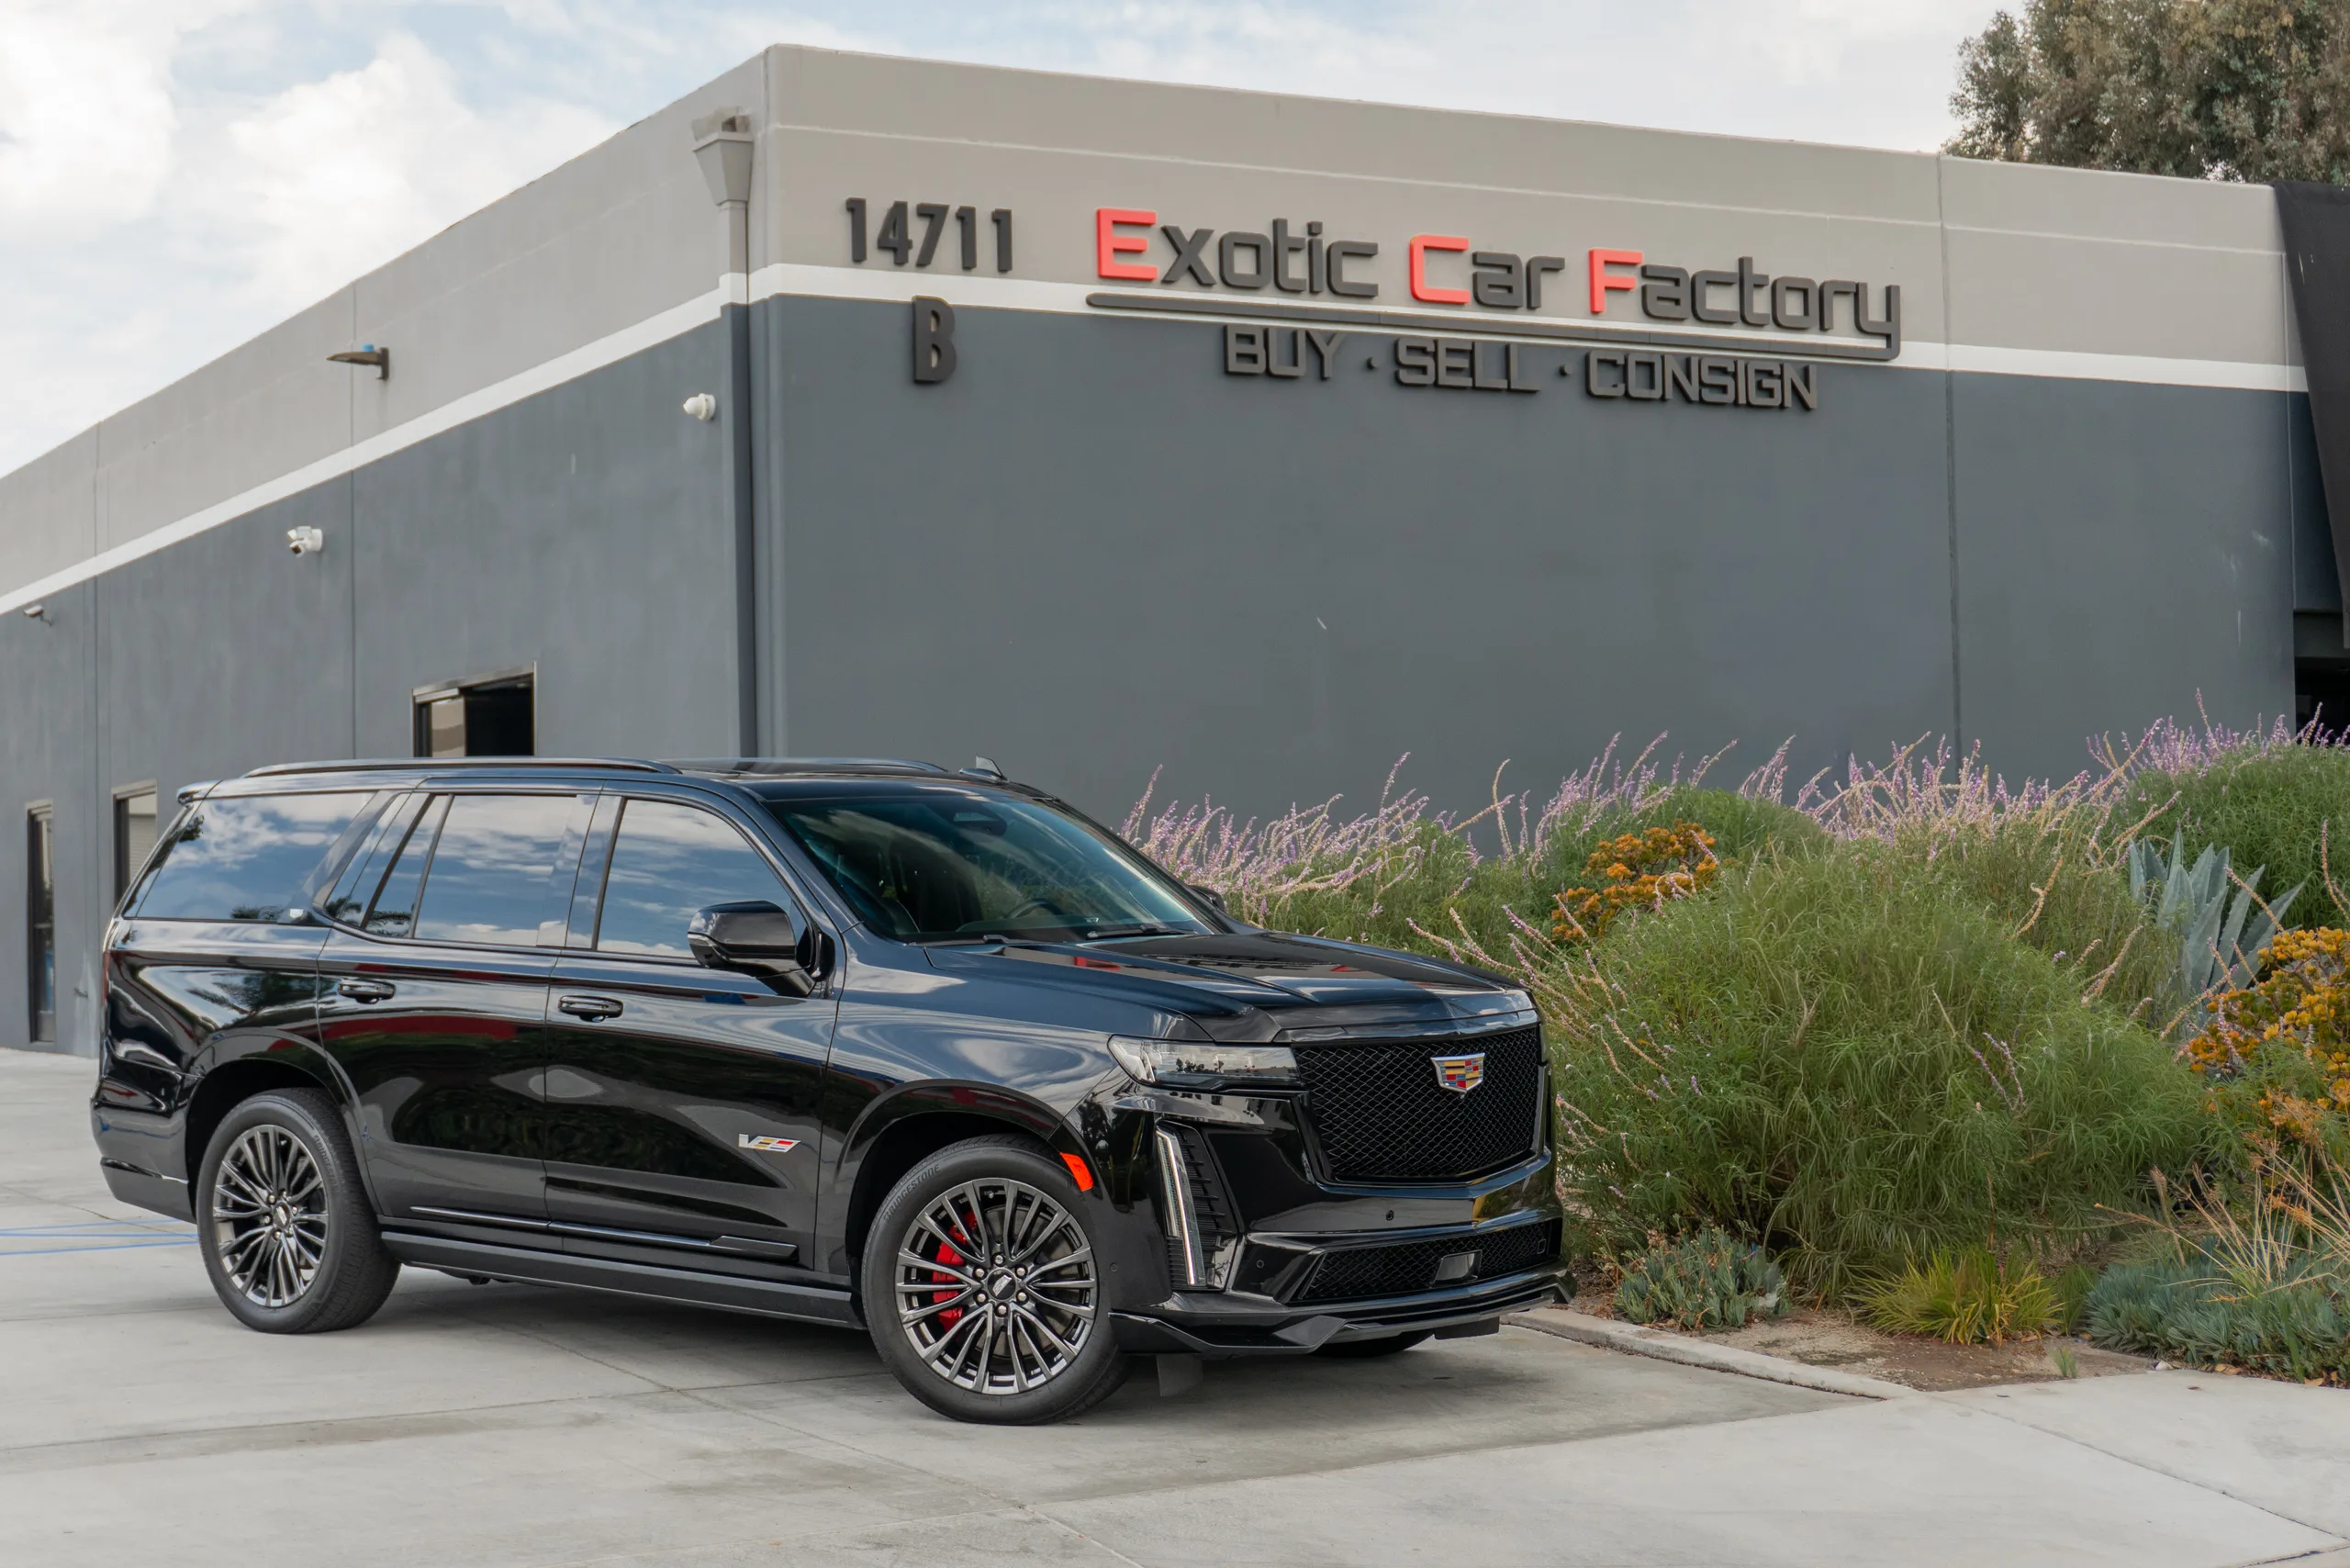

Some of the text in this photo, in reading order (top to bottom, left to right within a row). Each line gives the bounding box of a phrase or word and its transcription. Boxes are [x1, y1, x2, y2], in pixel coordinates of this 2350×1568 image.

[845, 196, 1013, 272] 14711
[1095, 207, 1901, 360] Exotic Car Factory
[912, 295, 957, 385] B
[1223, 324, 1818, 410] BUY SELL CONSIGN
[883, 1163, 942, 1225] BRIDGESTONE
